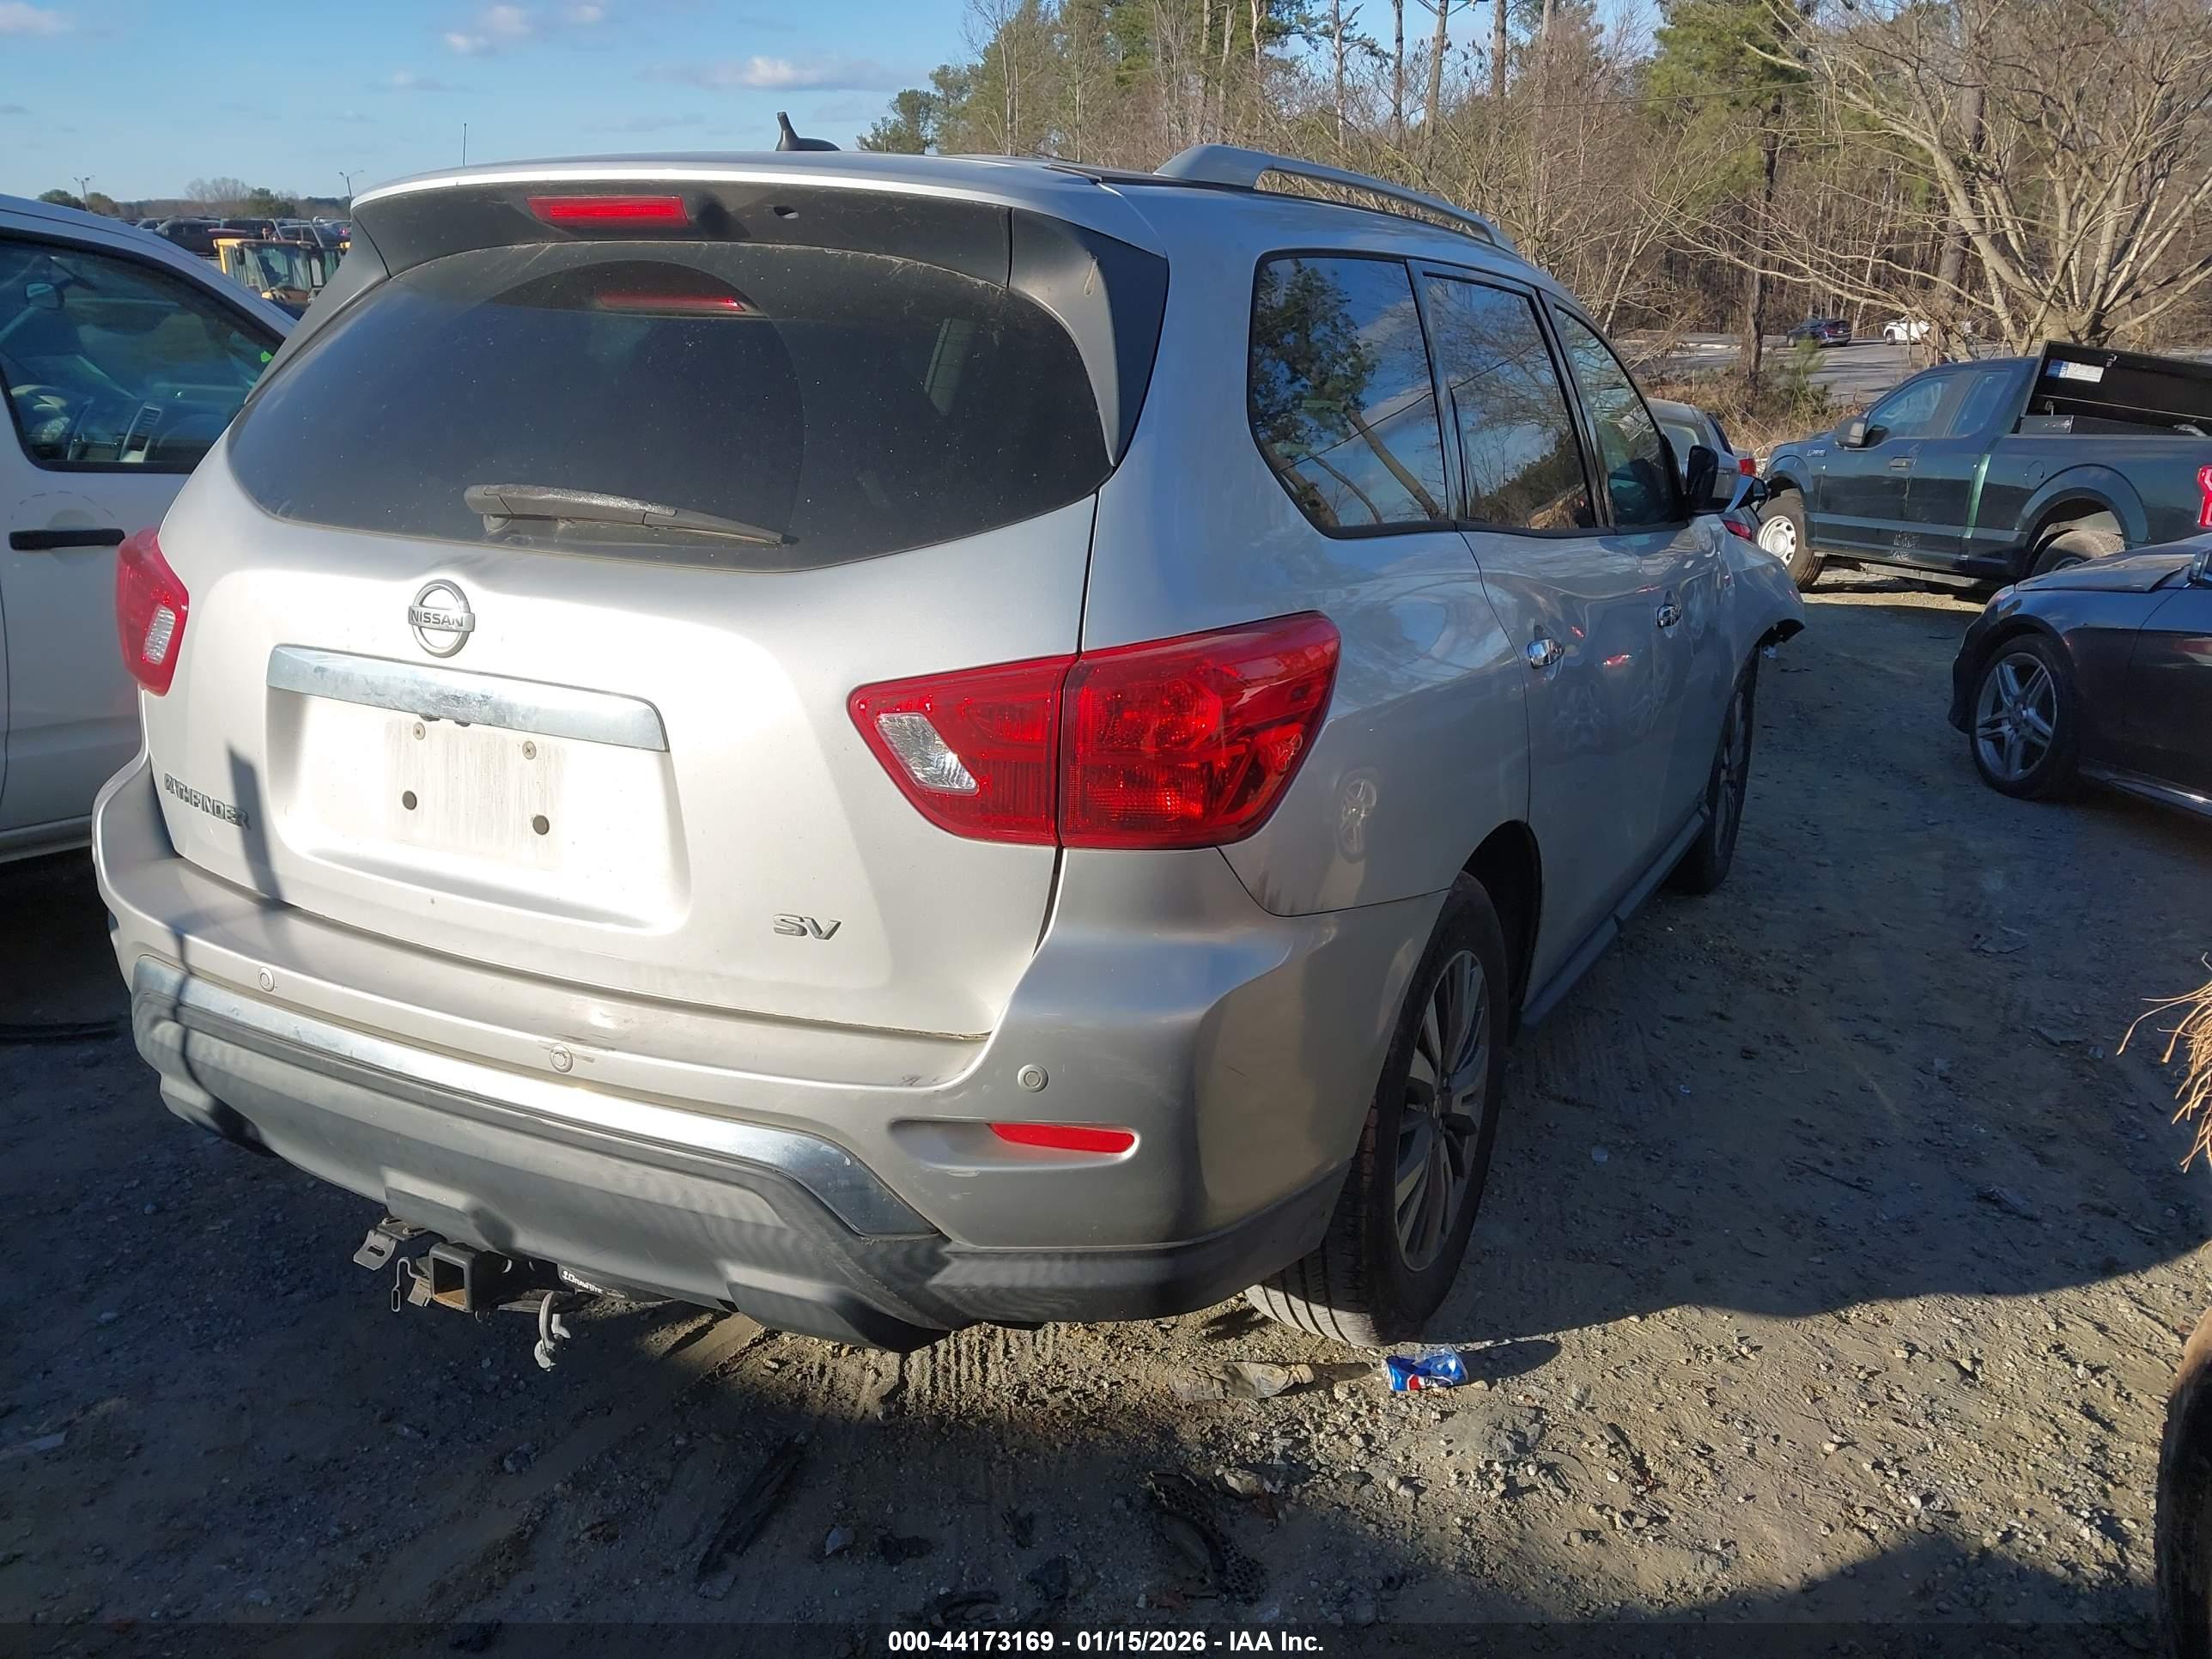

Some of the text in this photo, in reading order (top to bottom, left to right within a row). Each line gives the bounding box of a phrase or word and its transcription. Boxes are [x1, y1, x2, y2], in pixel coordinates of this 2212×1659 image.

[410, 610, 464, 627] NISSAN
[164, 773, 251, 830] PATHFINDER
[773, 913, 842, 940] SV
